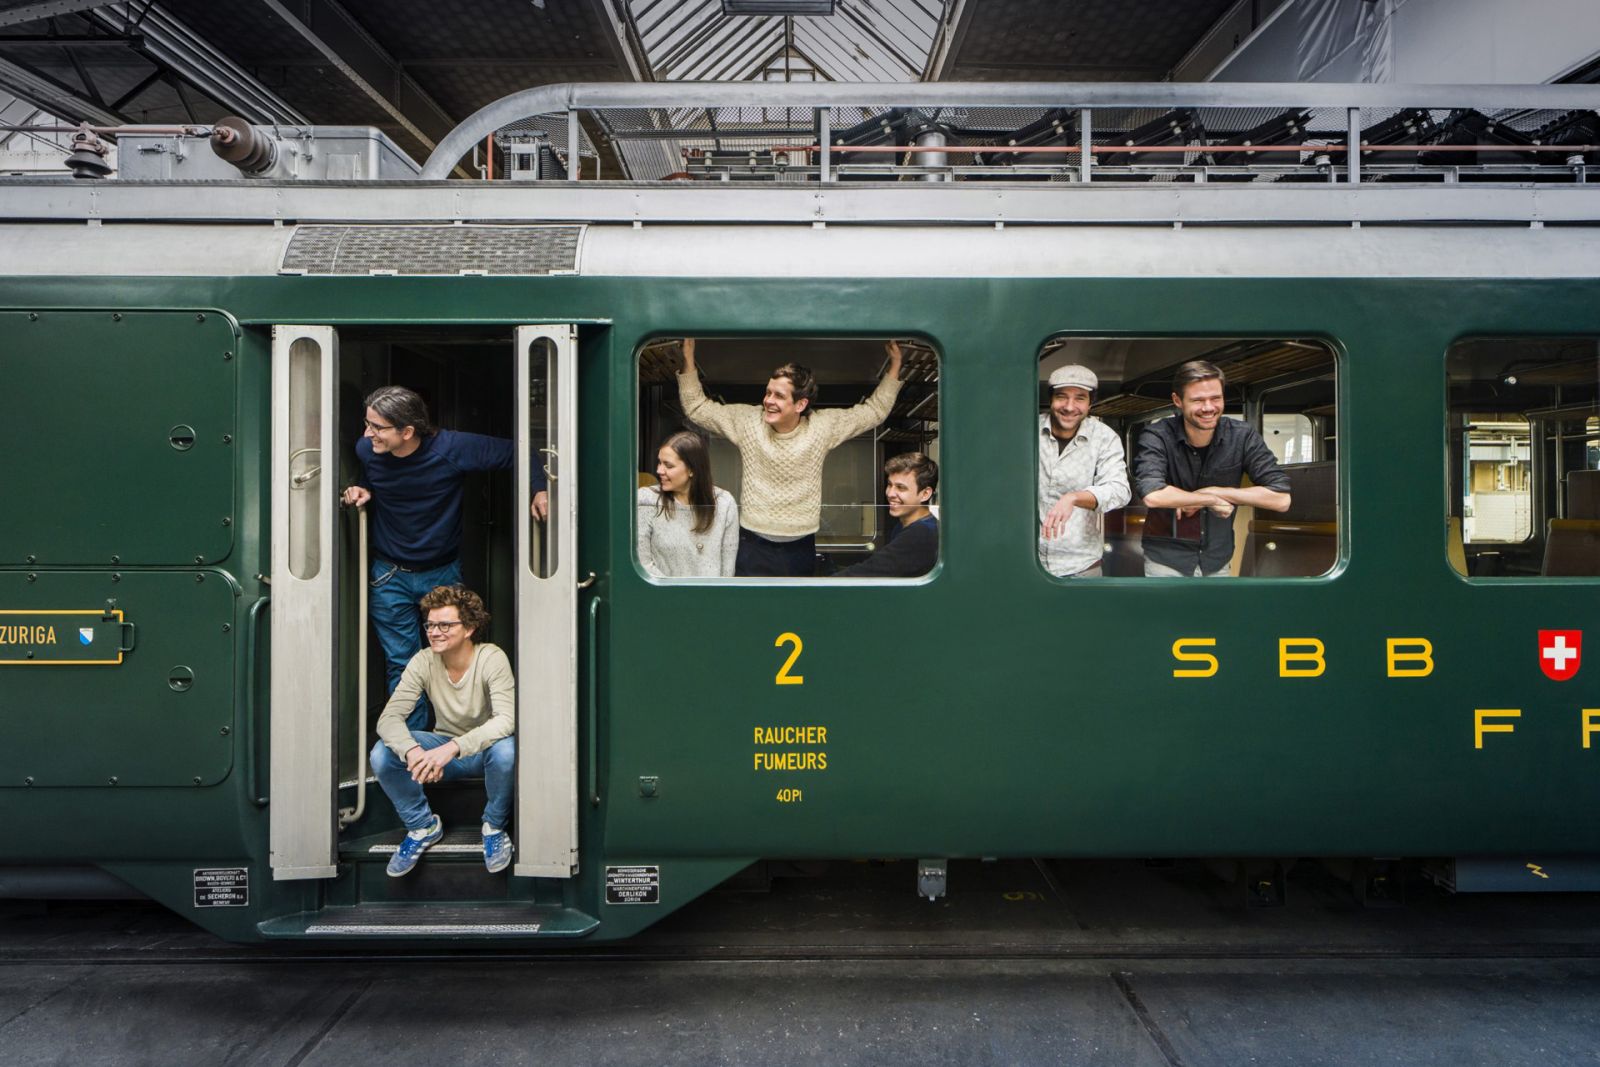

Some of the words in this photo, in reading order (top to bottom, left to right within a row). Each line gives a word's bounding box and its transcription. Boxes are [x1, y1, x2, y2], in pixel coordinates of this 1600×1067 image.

[0, 625, 57, 645] ZURIGA
[774, 632, 804, 685] 2
[754, 726, 827, 745] RAUCHER
[754, 752, 827, 771] FUMEURS
